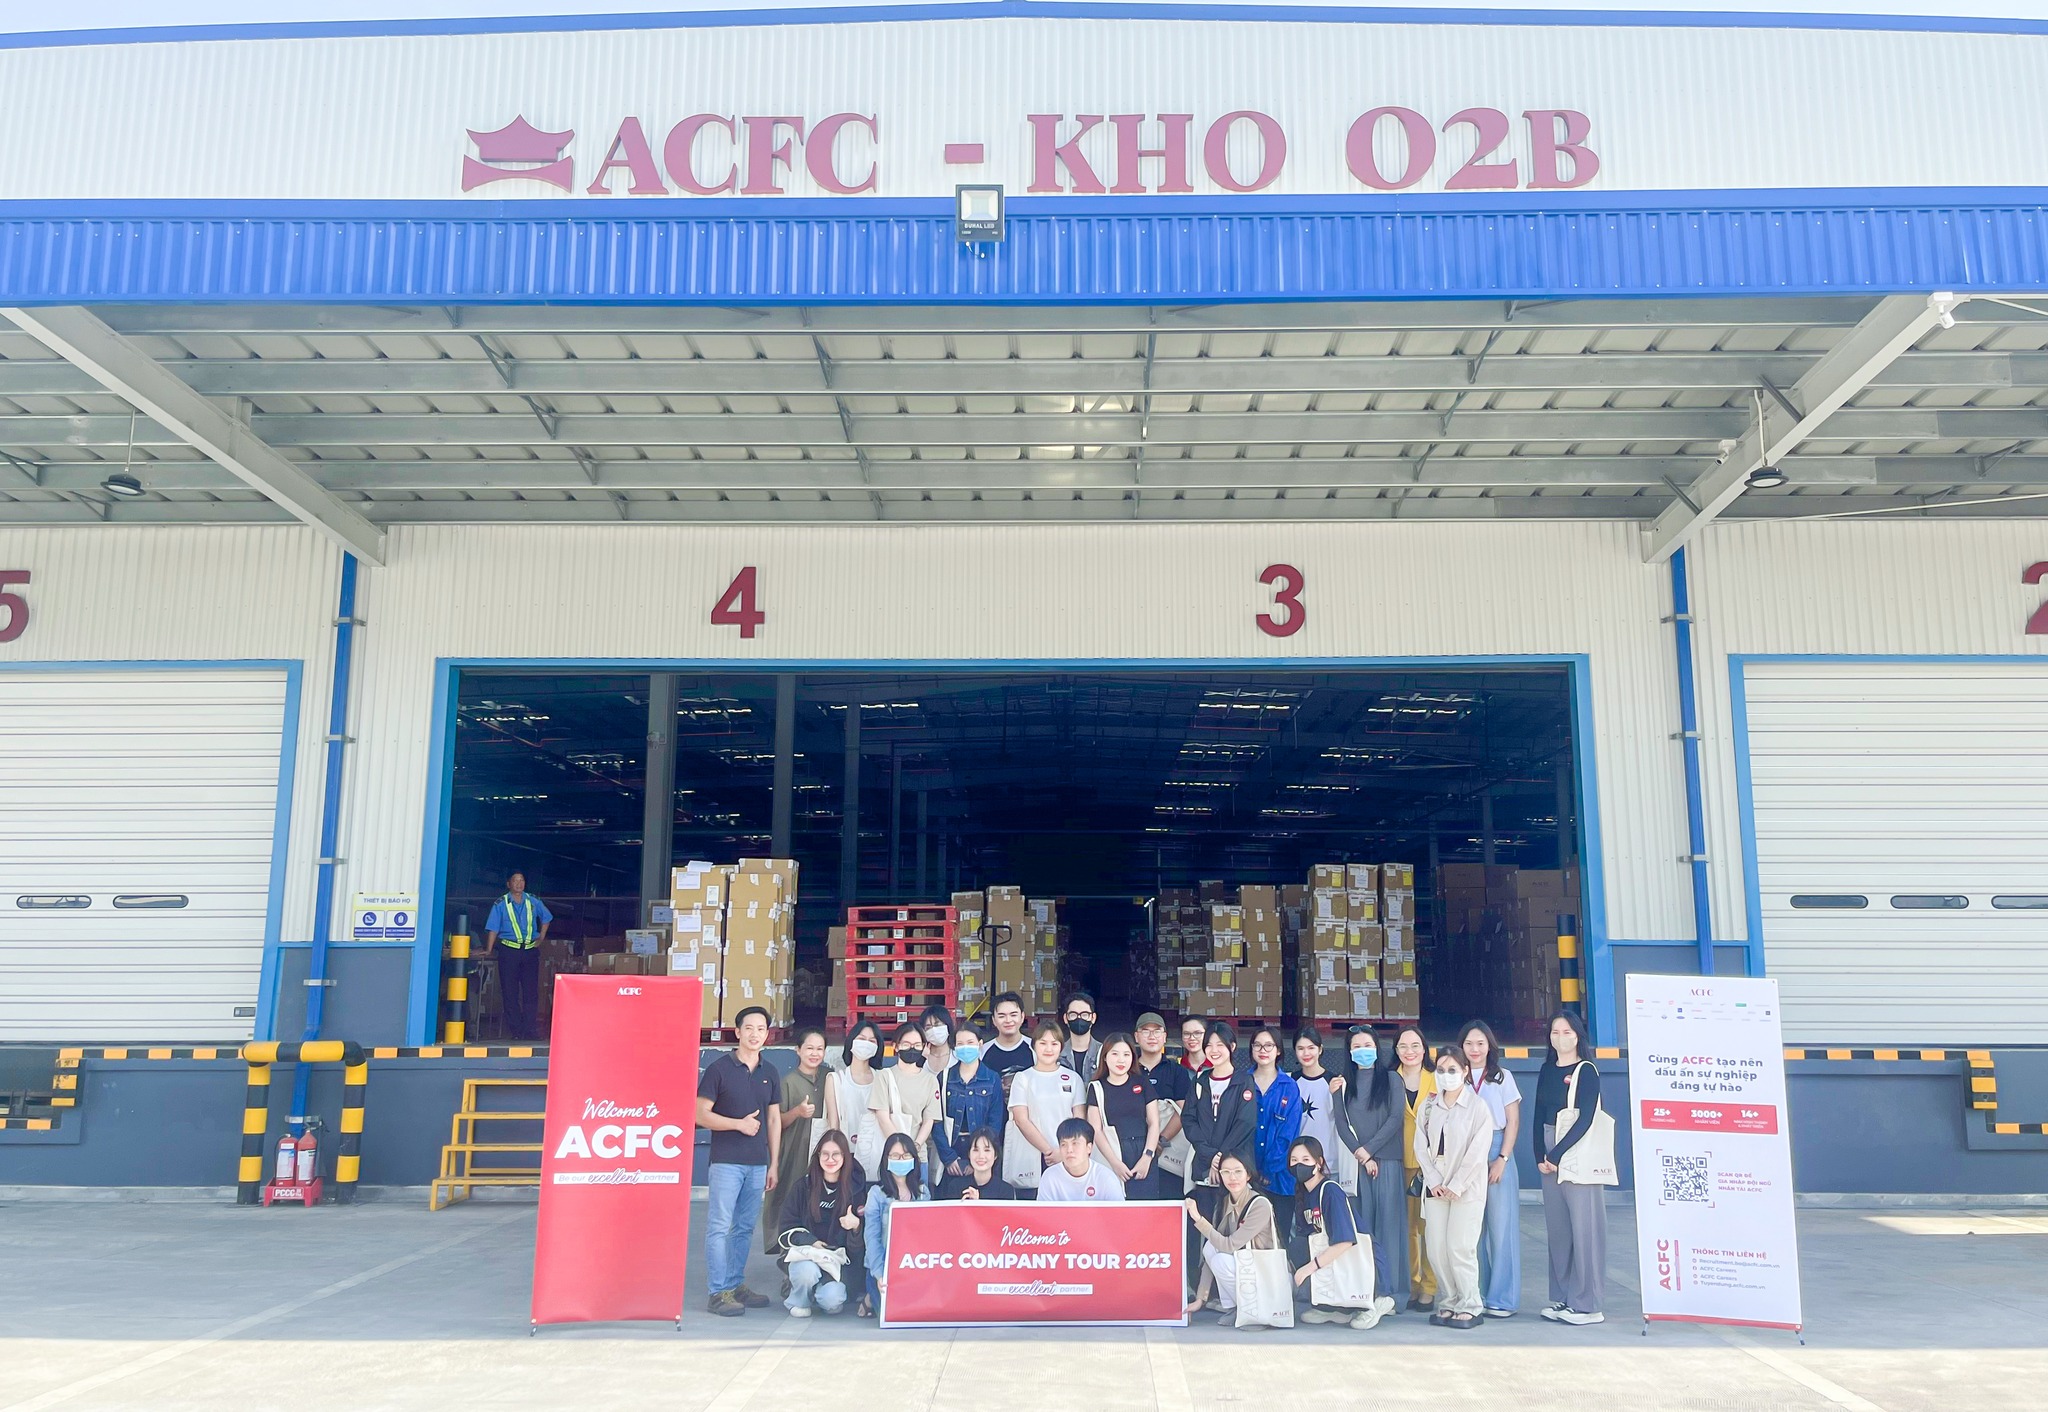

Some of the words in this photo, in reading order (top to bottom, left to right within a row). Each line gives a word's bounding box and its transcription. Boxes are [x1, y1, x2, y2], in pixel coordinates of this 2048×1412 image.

[587, 113, 878, 195] ACFC
[1027, 111, 1287, 193] KHO
[0, 570, 31, 643] 5
[711, 566, 765, 638] 4
[1256, 564, 1305, 637] 3
[617, 987, 642, 996] ACFC
[1690, 989, 1713, 997] ACFC
[1648, 1054, 1678, 1065] Cùng
[1681, 1056, 1713, 1065] ACFC
[1716, 1057, 1736, 1068] tạo
[1740, 1057, 1763, 1067] nên
[1655, 1067, 1676, 1077] dấu
[1680, 1067, 1694, 1077] ấn
[1698, 1070, 1711, 1080] sự
[1715, 1070, 1757, 1081] nghiệp
[1670, 1081, 1700, 1092] đáng
[1703, 1082, 1717, 1093] tự
[1720, 1082, 1742, 1092] hào
[582, 1097, 644, 1120] Welcome
[645, 1102, 659, 1119] to
[1653, 1108, 1671, 1116] 25+
[1691, 1109, 1723, 1119] 3000+
[1741, 1109, 1759, 1119] 14+
[554, 1125, 683, 1159] ACFC
[558, 1174, 569, 1182] Be
[588, 1168, 641, 1184] excellent
[643, 1174, 675, 1183] partner
[275, 1189, 295, 1197] PCCC
[1000, 1225, 1056, 1247] Welcome
[1057, 1230, 1071, 1246] to
[899, 1253, 953, 1269] ACFC
[958, 1253, 1060, 1269] COMPANY
[1064, 1253, 1120, 1269] TOUR
[1125, 1253, 1171, 1269] 2023
[1737, 1250, 1754, 1258] LIÊN
[1756, 1251, 1767, 1259] HỆ
[1657, 1239, 1671, 1291] ACFC
[982, 1285, 993, 1293] Be
[1008, 1279, 1056, 1296] excellent
[1059, 1286, 1089, 1295] partner
